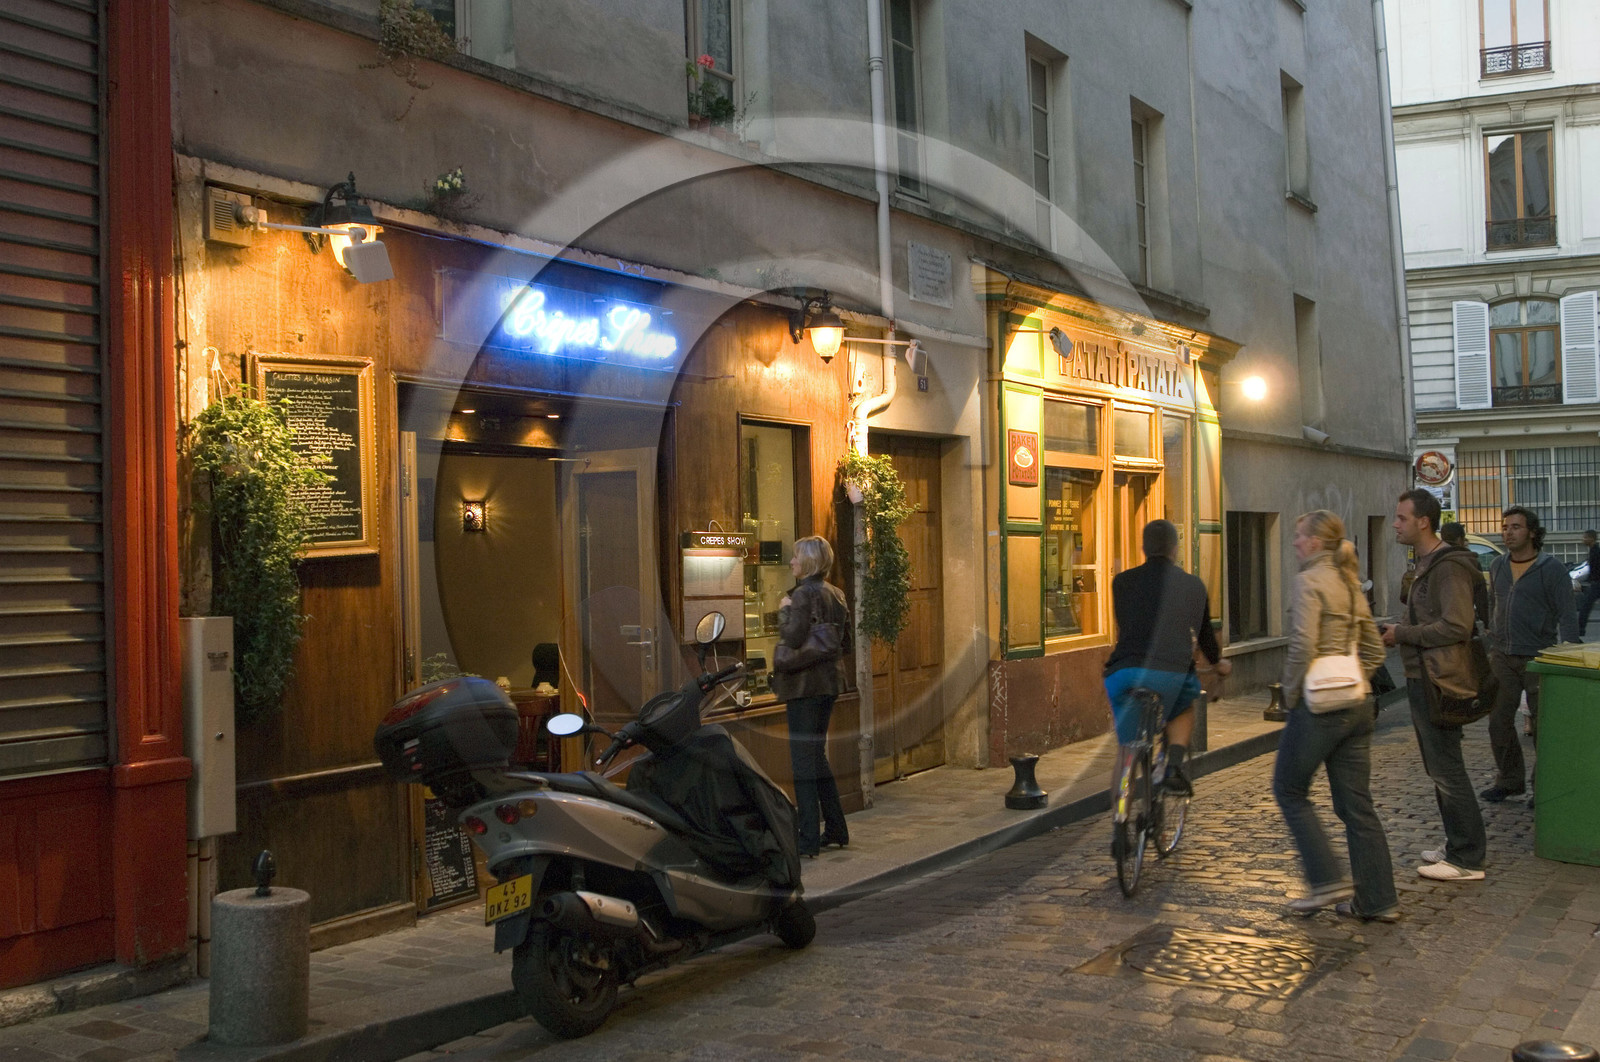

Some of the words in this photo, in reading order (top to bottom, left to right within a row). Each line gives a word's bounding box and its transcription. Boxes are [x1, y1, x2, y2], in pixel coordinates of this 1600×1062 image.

[601, 306, 677, 358] Show
[1126, 352, 1184, 398] PATATA
[920, 379, 926, 390] 51
[1011, 435, 1037, 453] BAKED
[1012, 462, 1036, 480] POTATOES
[700, 536, 725, 545] CREPES
[727, 536, 747, 545] SHOW
[503, 881, 517, 896] 43
[513, 892, 527, 908] 92
